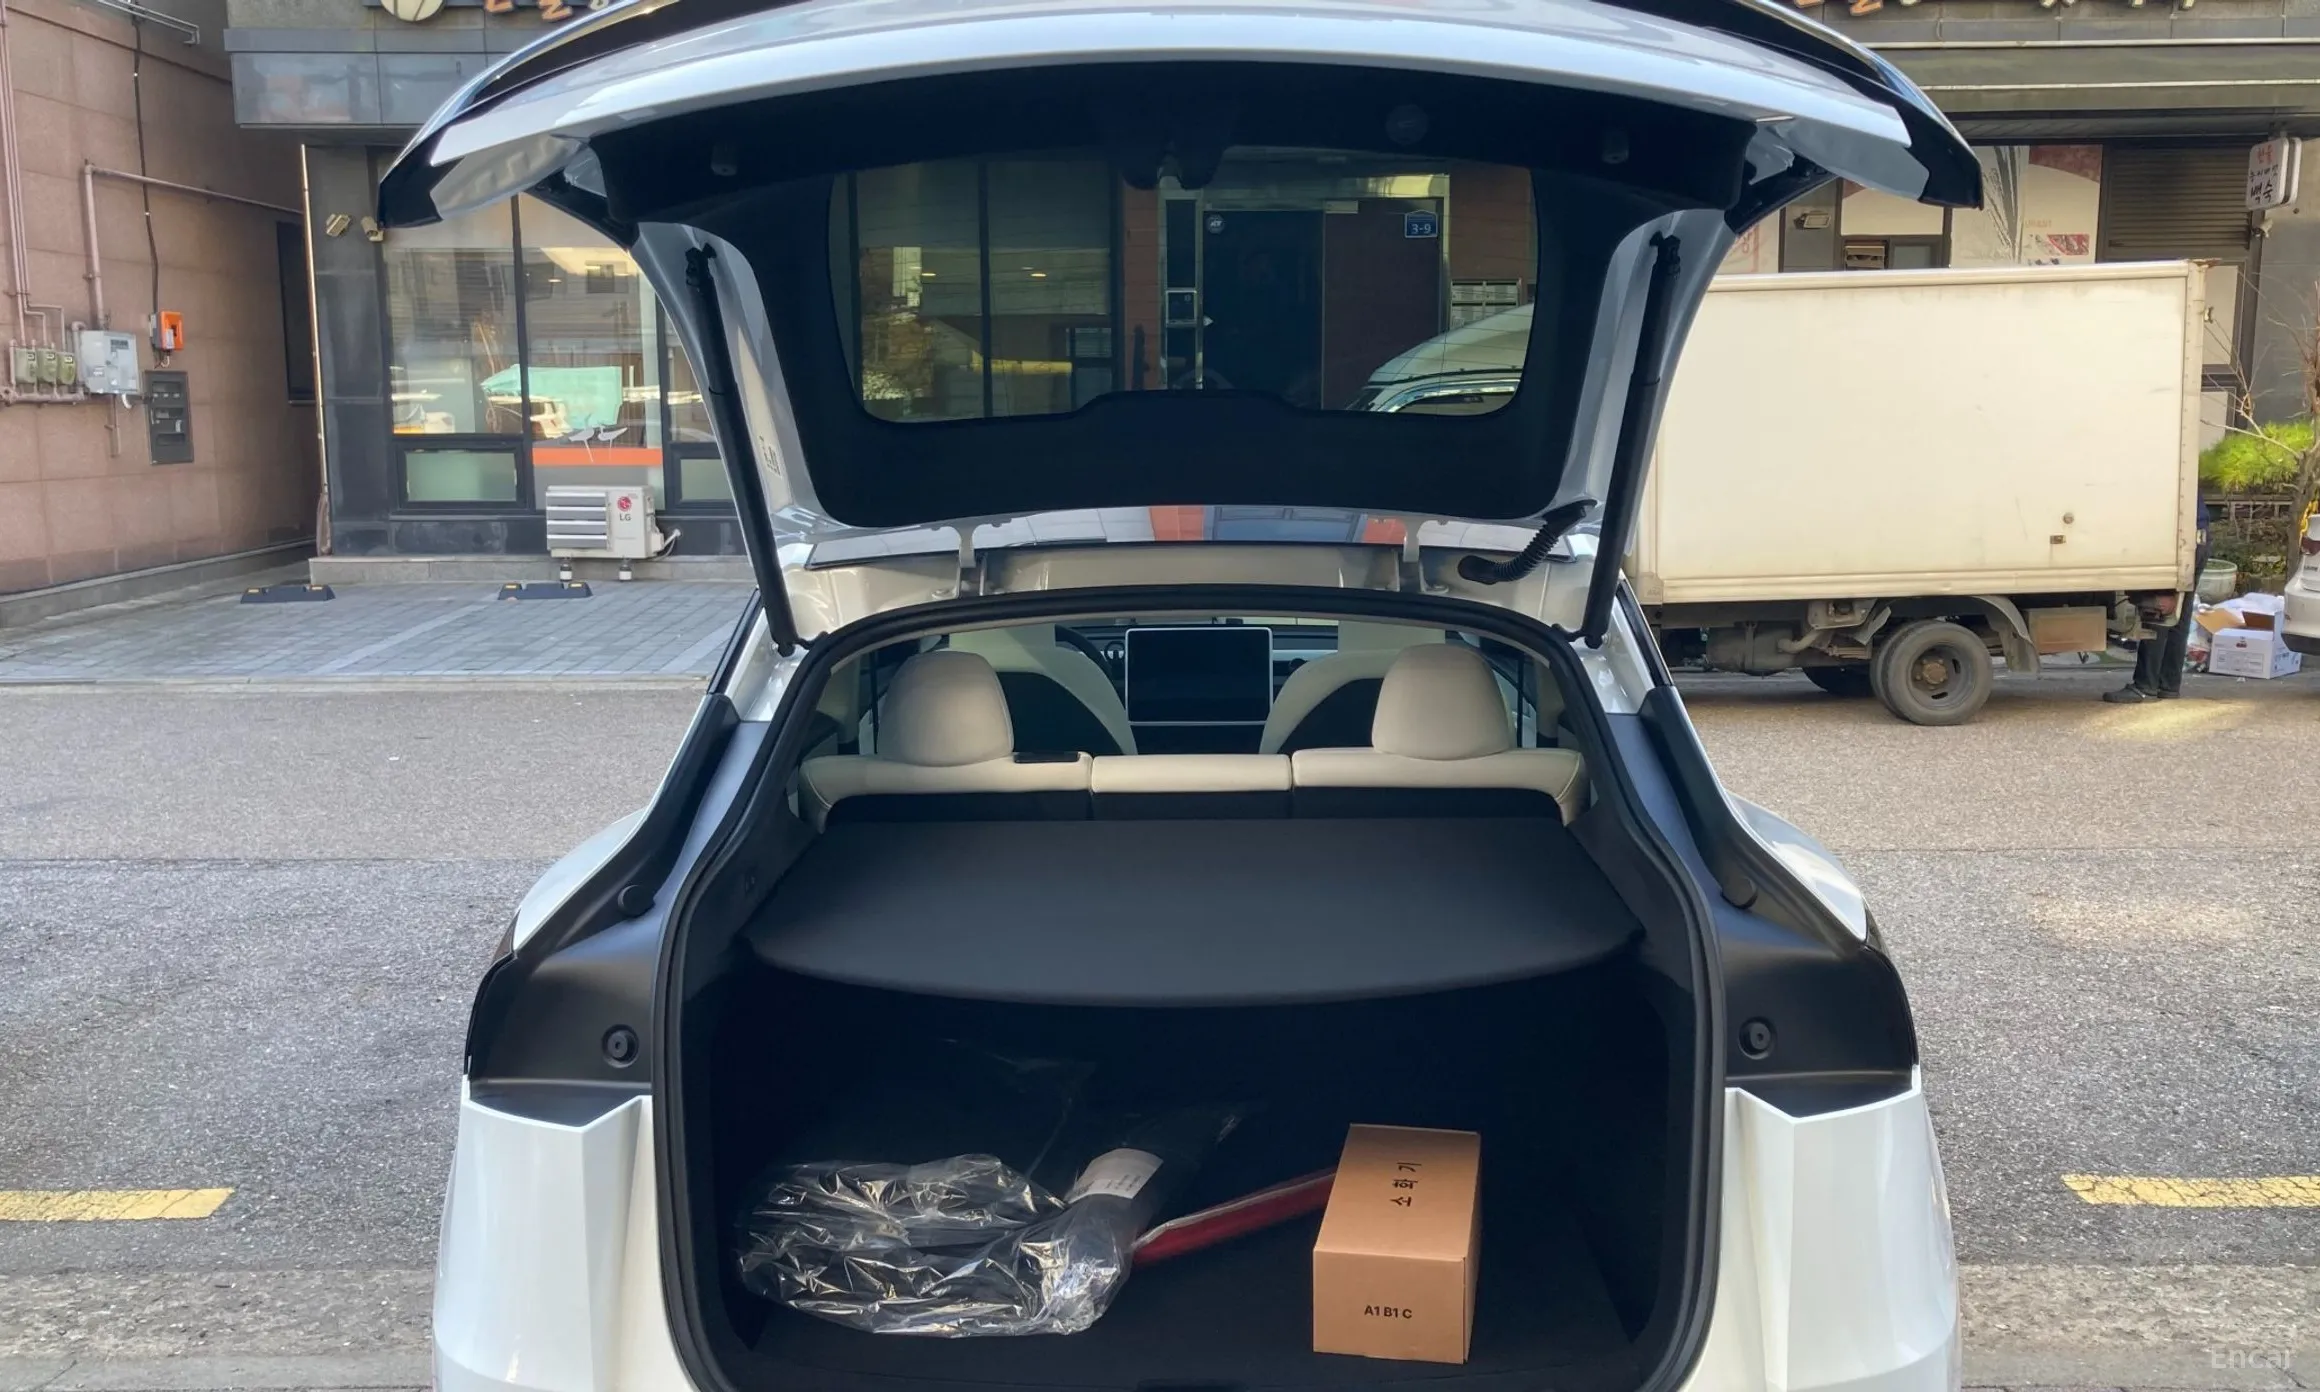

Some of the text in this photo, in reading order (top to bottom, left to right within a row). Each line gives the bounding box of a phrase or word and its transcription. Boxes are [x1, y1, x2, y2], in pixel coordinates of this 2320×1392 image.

[2250, 179, 2273, 203] 백숙
[1411, 223, 1432, 235] 3-9
[619, 513, 632, 522] LG
[1389, 1162, 1422, 1207] 소화기
[1364, 1305, 1413, 1319] A1 B1 C
